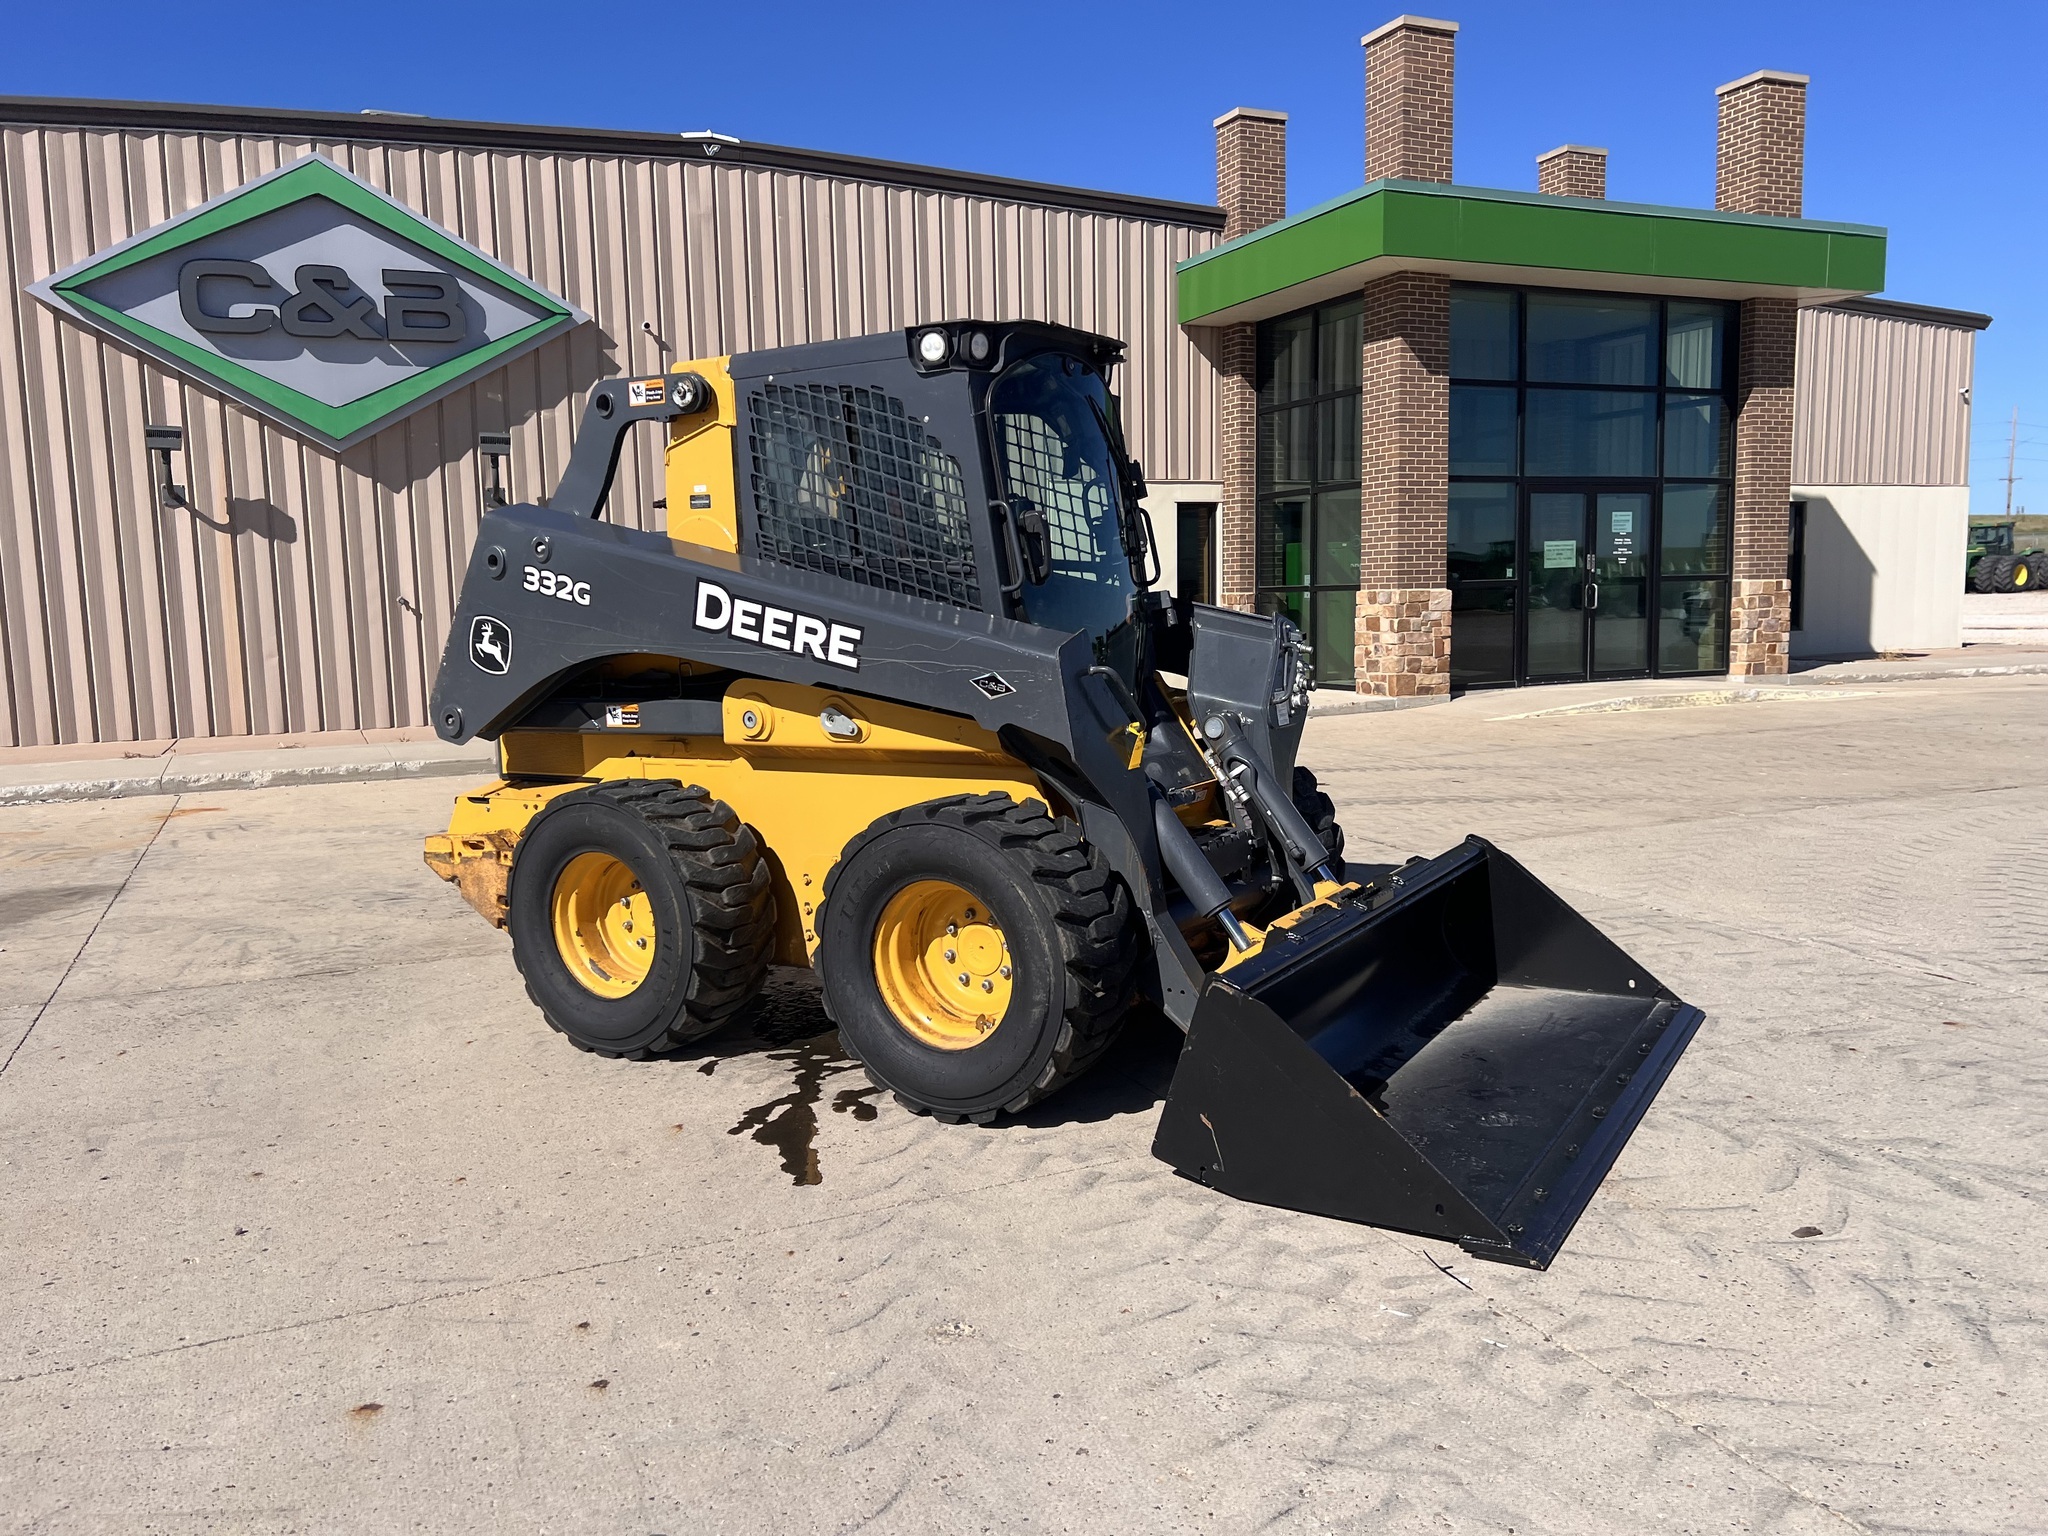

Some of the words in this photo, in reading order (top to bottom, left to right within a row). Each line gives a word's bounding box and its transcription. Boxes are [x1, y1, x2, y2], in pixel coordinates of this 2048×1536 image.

[178, 258, 466, 342] C&B
[523, 566, 591, 606] 332G
[695, 581, 862, 668] DEERE
[979, 680, 1005, 692] C&B
